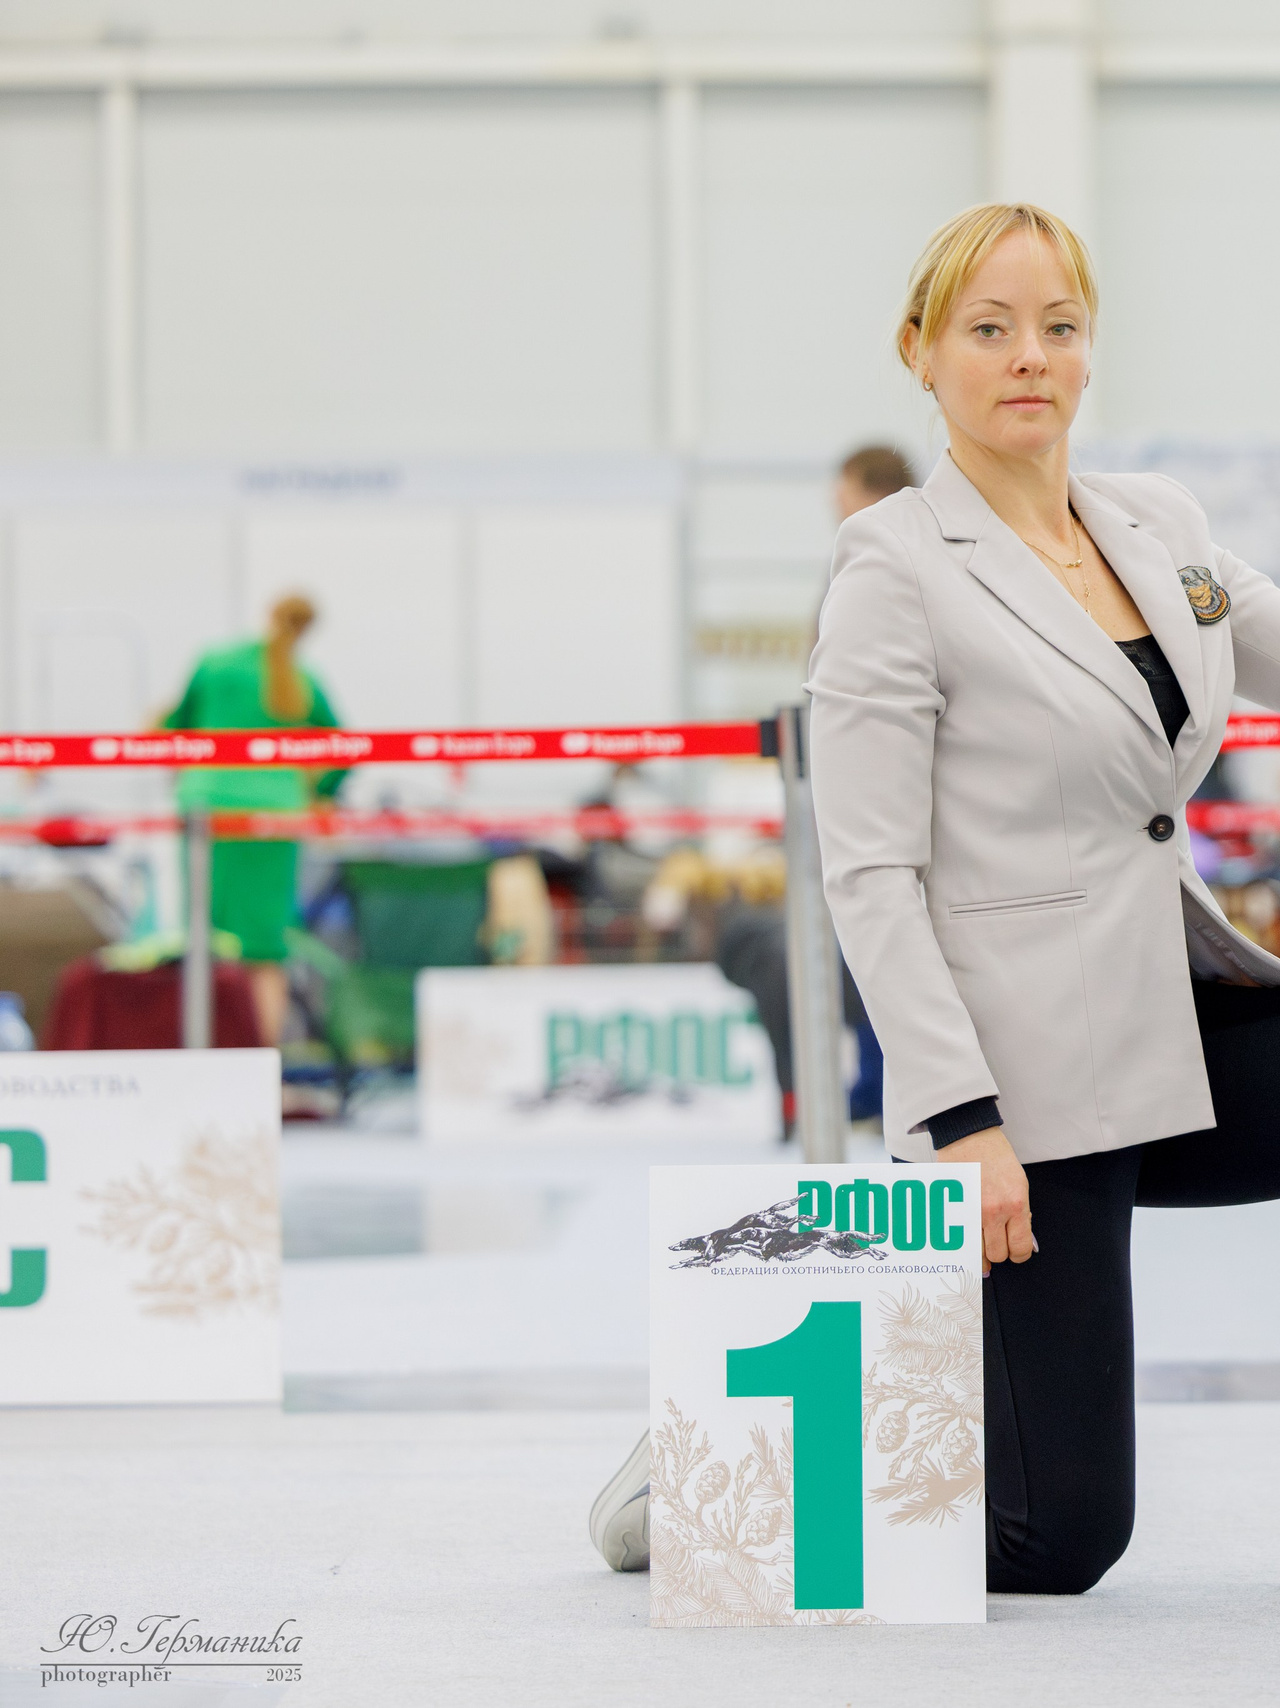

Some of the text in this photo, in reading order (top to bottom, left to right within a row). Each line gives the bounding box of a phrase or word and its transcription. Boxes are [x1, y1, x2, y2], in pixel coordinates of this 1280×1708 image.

[797, 1178, 965, 1251] РФОС
[710, 1264, 966, 1276] ФЕДЕРАЦИЯ ОХОТНИЧЬЕГО СОБАКОВОДСТВА
[726, 1301, 864, 1610] 1
